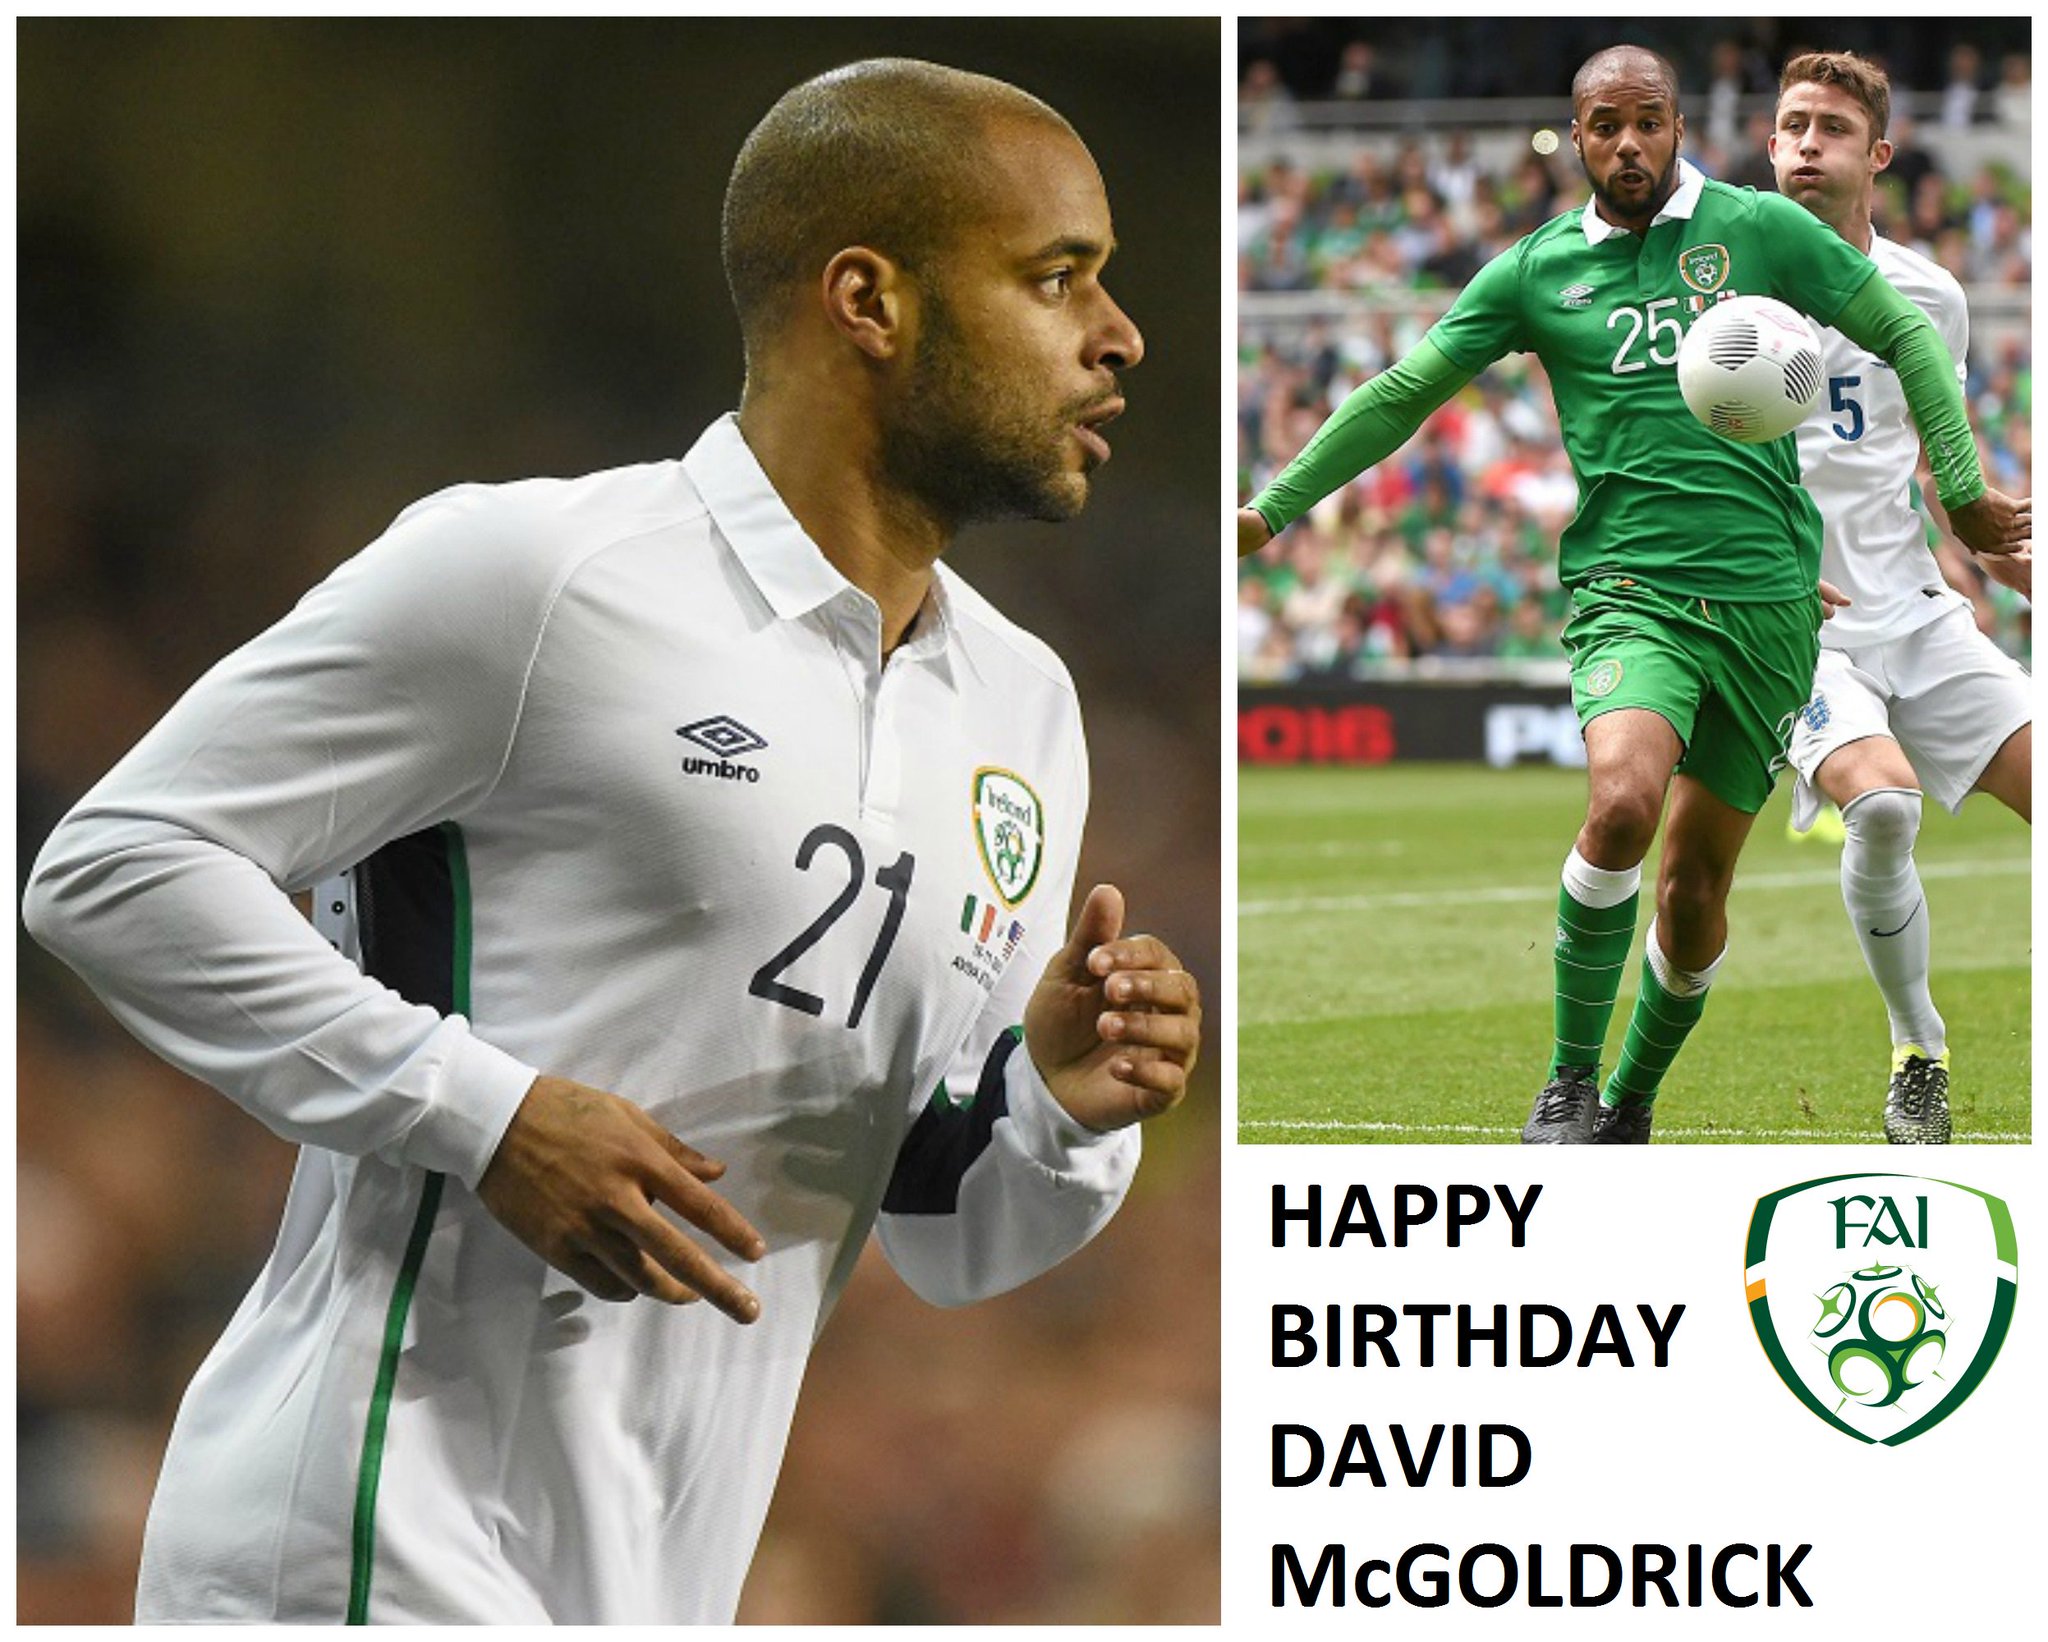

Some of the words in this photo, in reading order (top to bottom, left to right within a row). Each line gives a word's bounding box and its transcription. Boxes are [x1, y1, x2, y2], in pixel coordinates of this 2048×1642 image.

[1606, 297, 1684, 375] 25
[1828, 376, 1865, 441] 5
[682, 757, 760, 783] umbro
[986, 784, 1032, 827] Ireland
[749, 823, 916, 1029] 21
